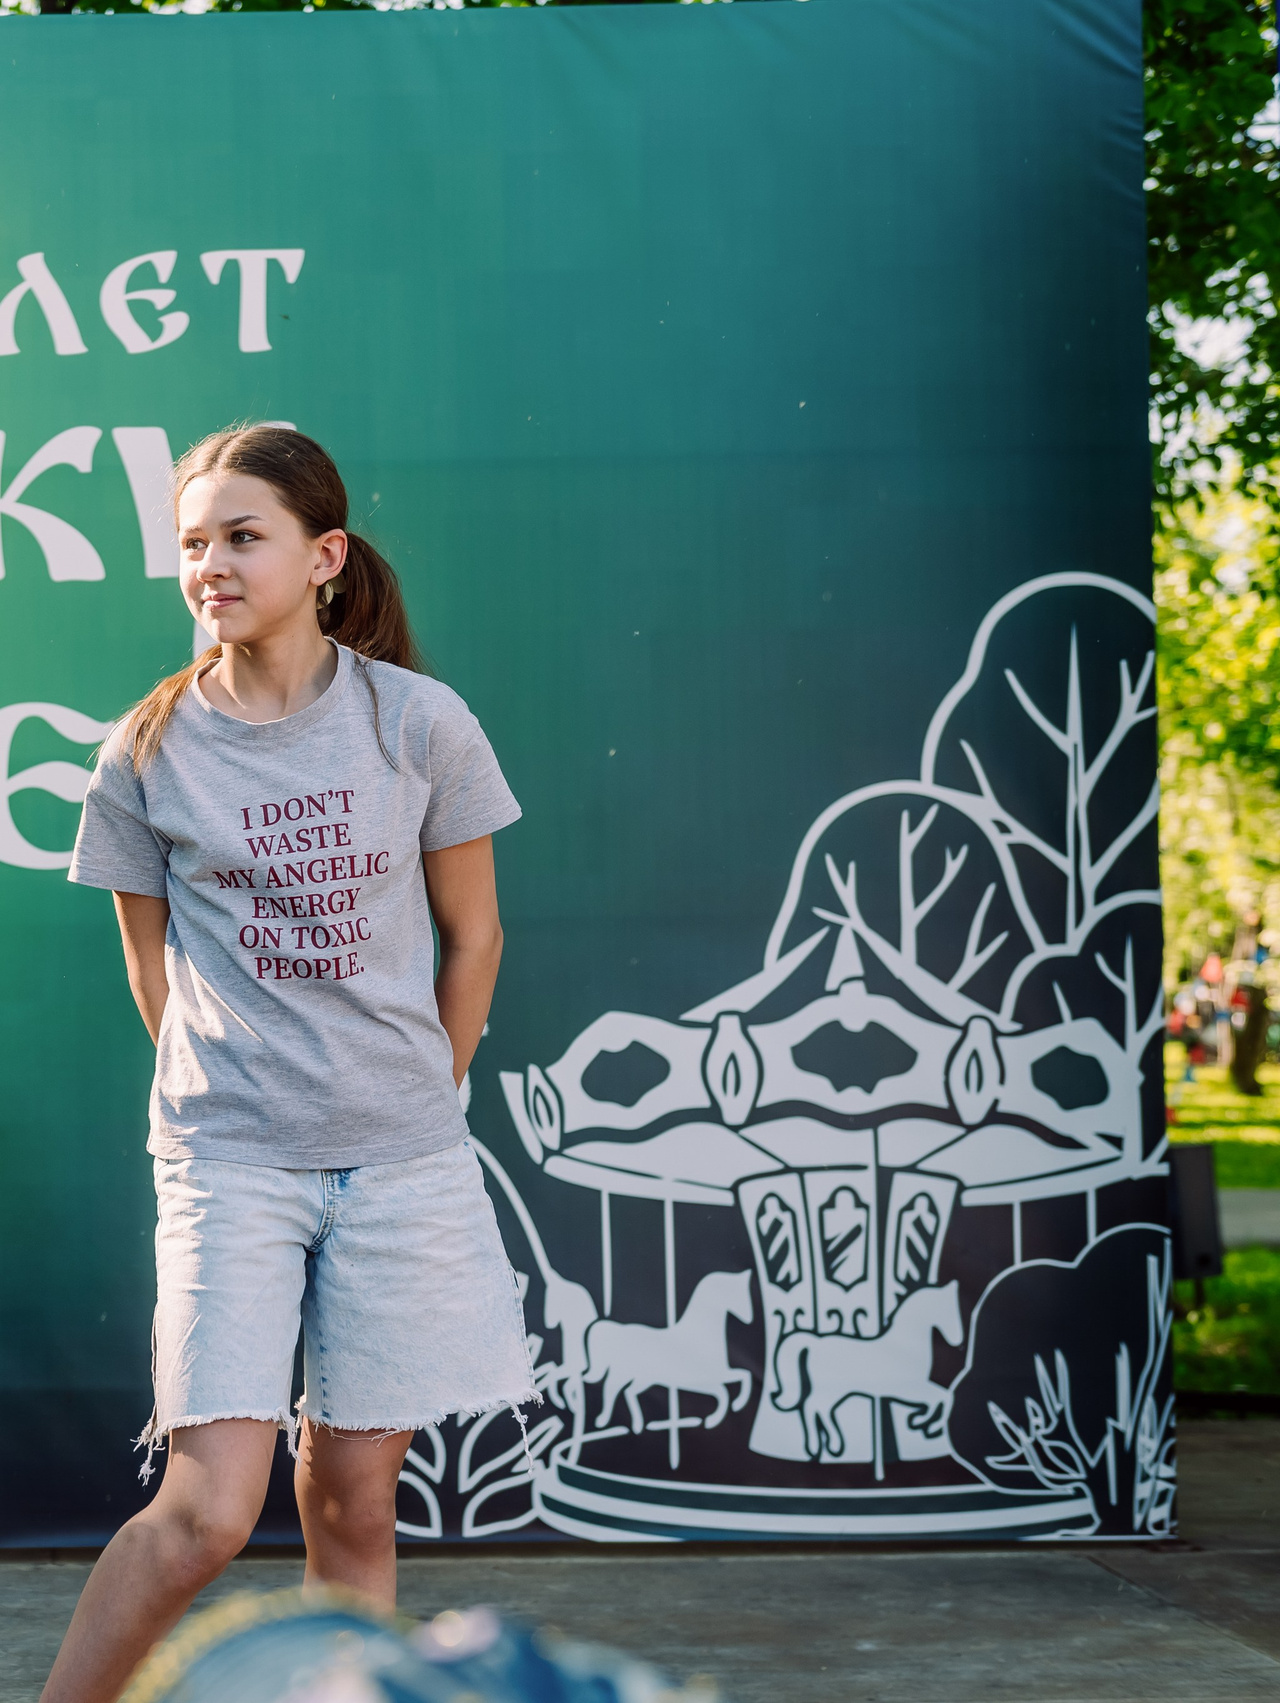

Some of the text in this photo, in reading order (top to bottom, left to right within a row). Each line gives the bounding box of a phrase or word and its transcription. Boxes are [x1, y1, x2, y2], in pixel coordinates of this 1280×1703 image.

[241, 790, 355, 830] I DON’T
[245, 823, 352, 859] WASTE
[212, 851, 390, 889] MY ANGELIC
[251, 887, 361, 919] ENERGY
[239, 917, 372, 950] ON TOXIC
[254, 952, 365, 981] PEOPLE.
